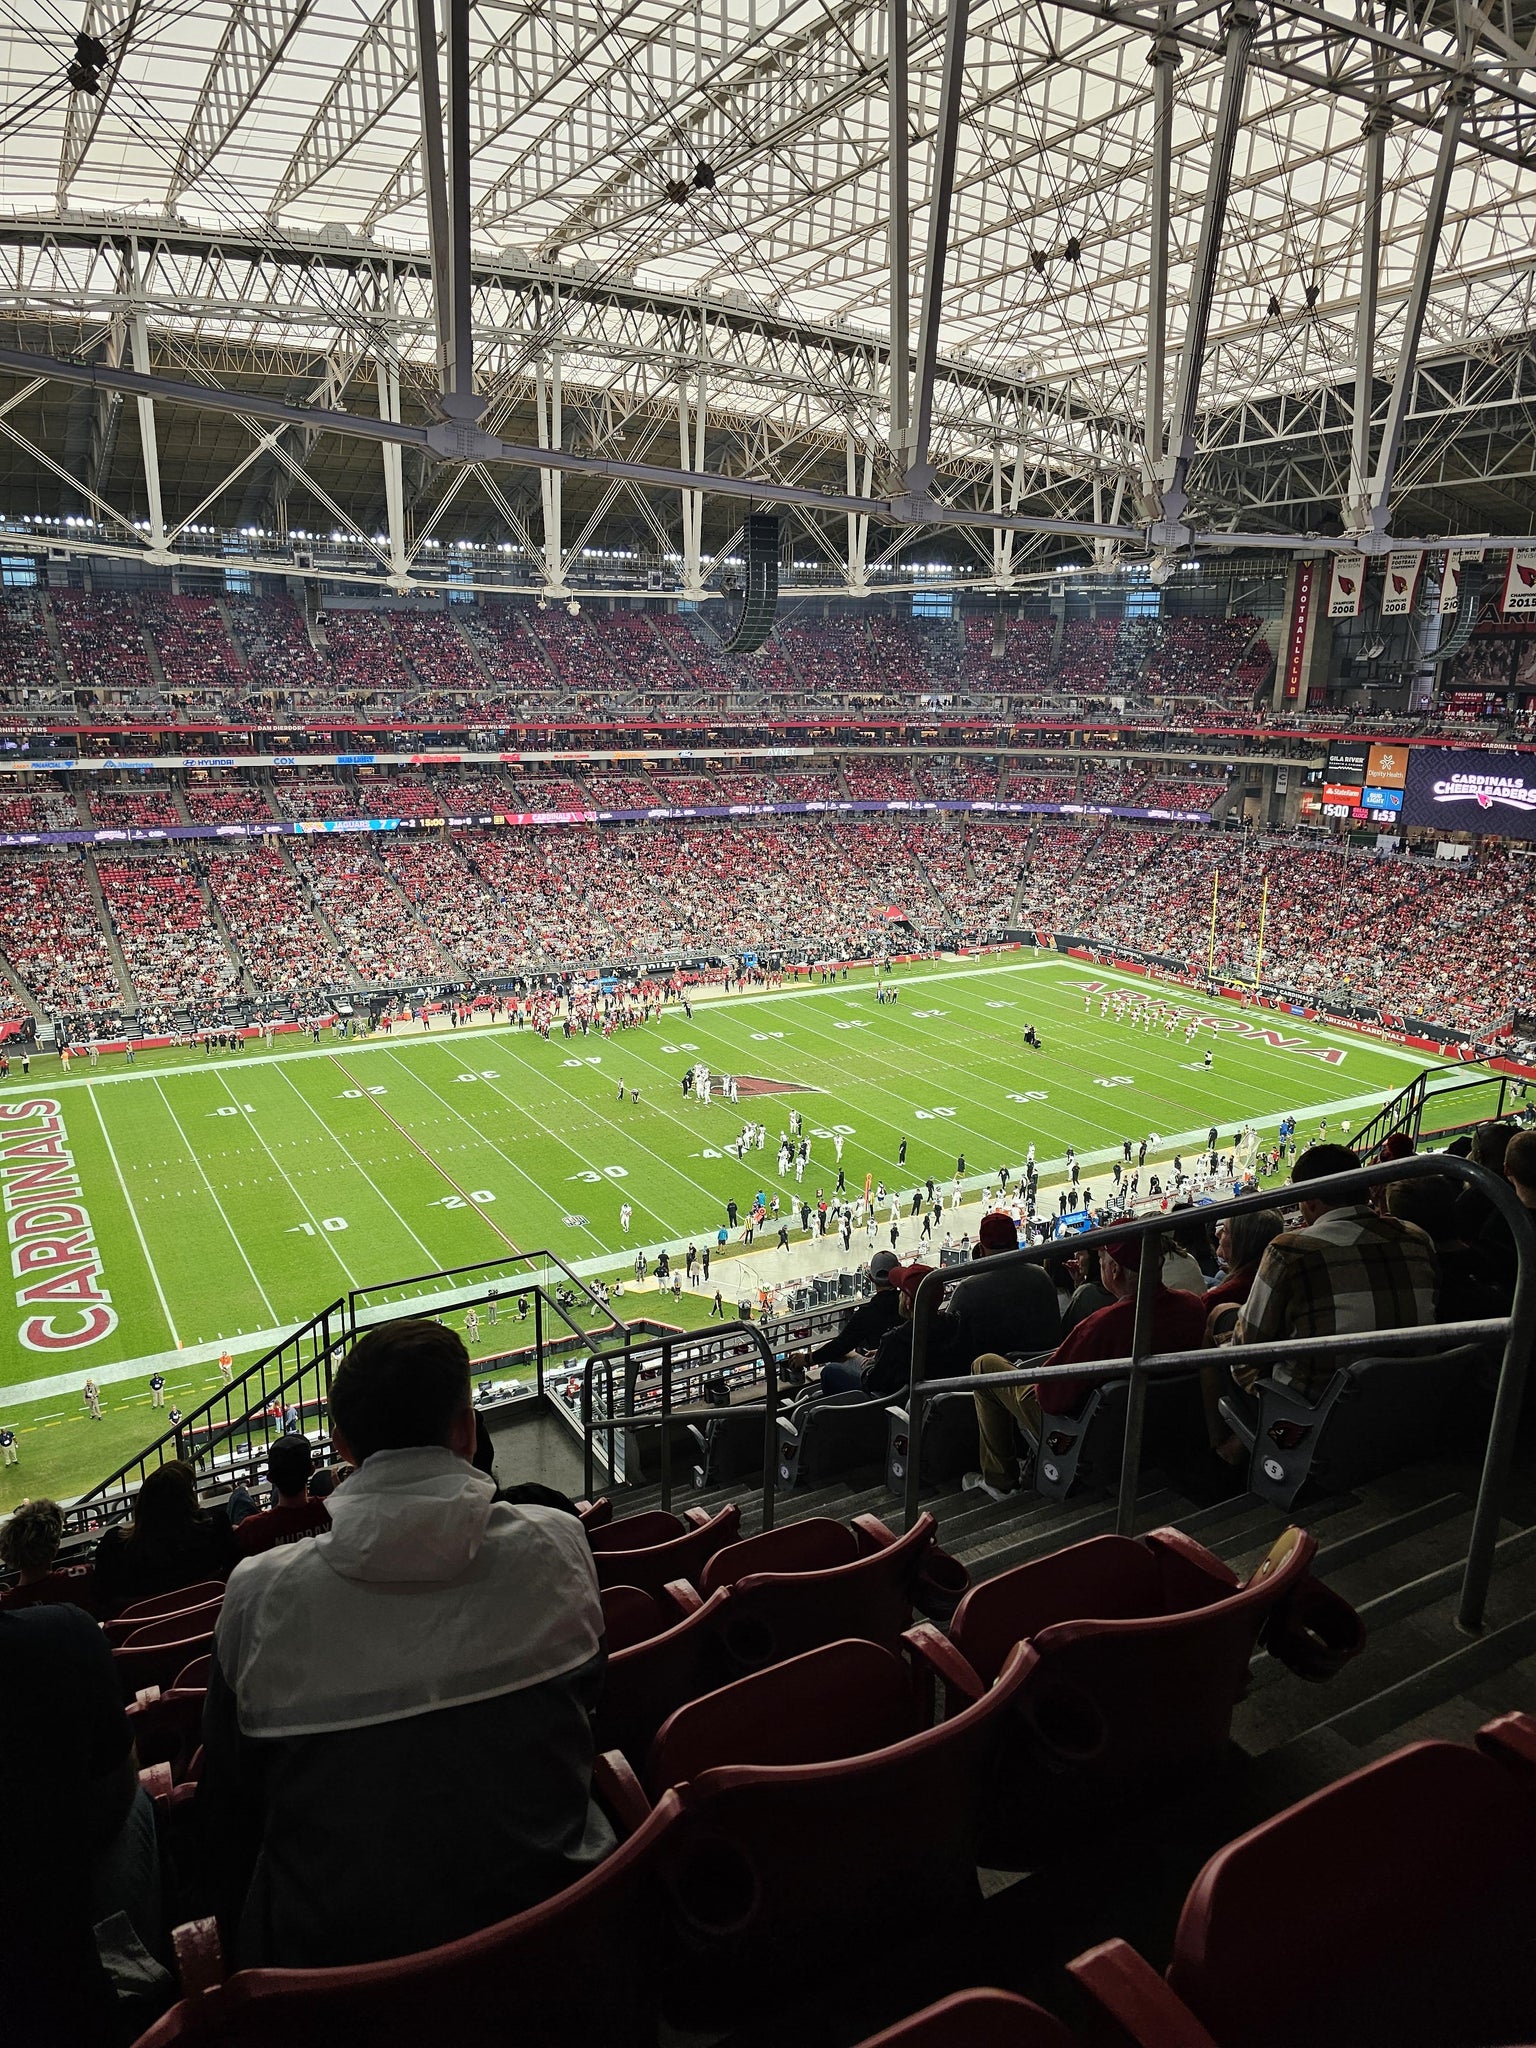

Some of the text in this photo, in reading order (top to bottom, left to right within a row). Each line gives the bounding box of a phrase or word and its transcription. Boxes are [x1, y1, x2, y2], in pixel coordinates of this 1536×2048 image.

[1332, 605, 1355, 614] 2008
[1385, 603, 1407, 612] 2008
[1295, 575, 1309, 654] FOOTBALL
[1290, 657, 1299, 694] CLUB
[767, 748, 796, 756] AVNET
[1481, 742, 1517, 750] CARDINALS
[273, 757, 295, 765] COX
[1368, 770, 1386, 778] Dignity
[1451, 774, 1524, 788] CARDINALS
[1433, 781, 1536, 803] CHEERLEADERS
[1323, 804, 1349, 817] 15:00
[1372, 809, 1396, 822] 1:53
[334, 821, 370, 829] JAGUARS
[420, 818, 445, 826] 15:00
[1279, 989, 1314, 1002] CARDINALS
[1323, 1015, 1406, 1042] ARIZONA CARDNALS
[0, 1098, 118, 1353] CARDINALS
